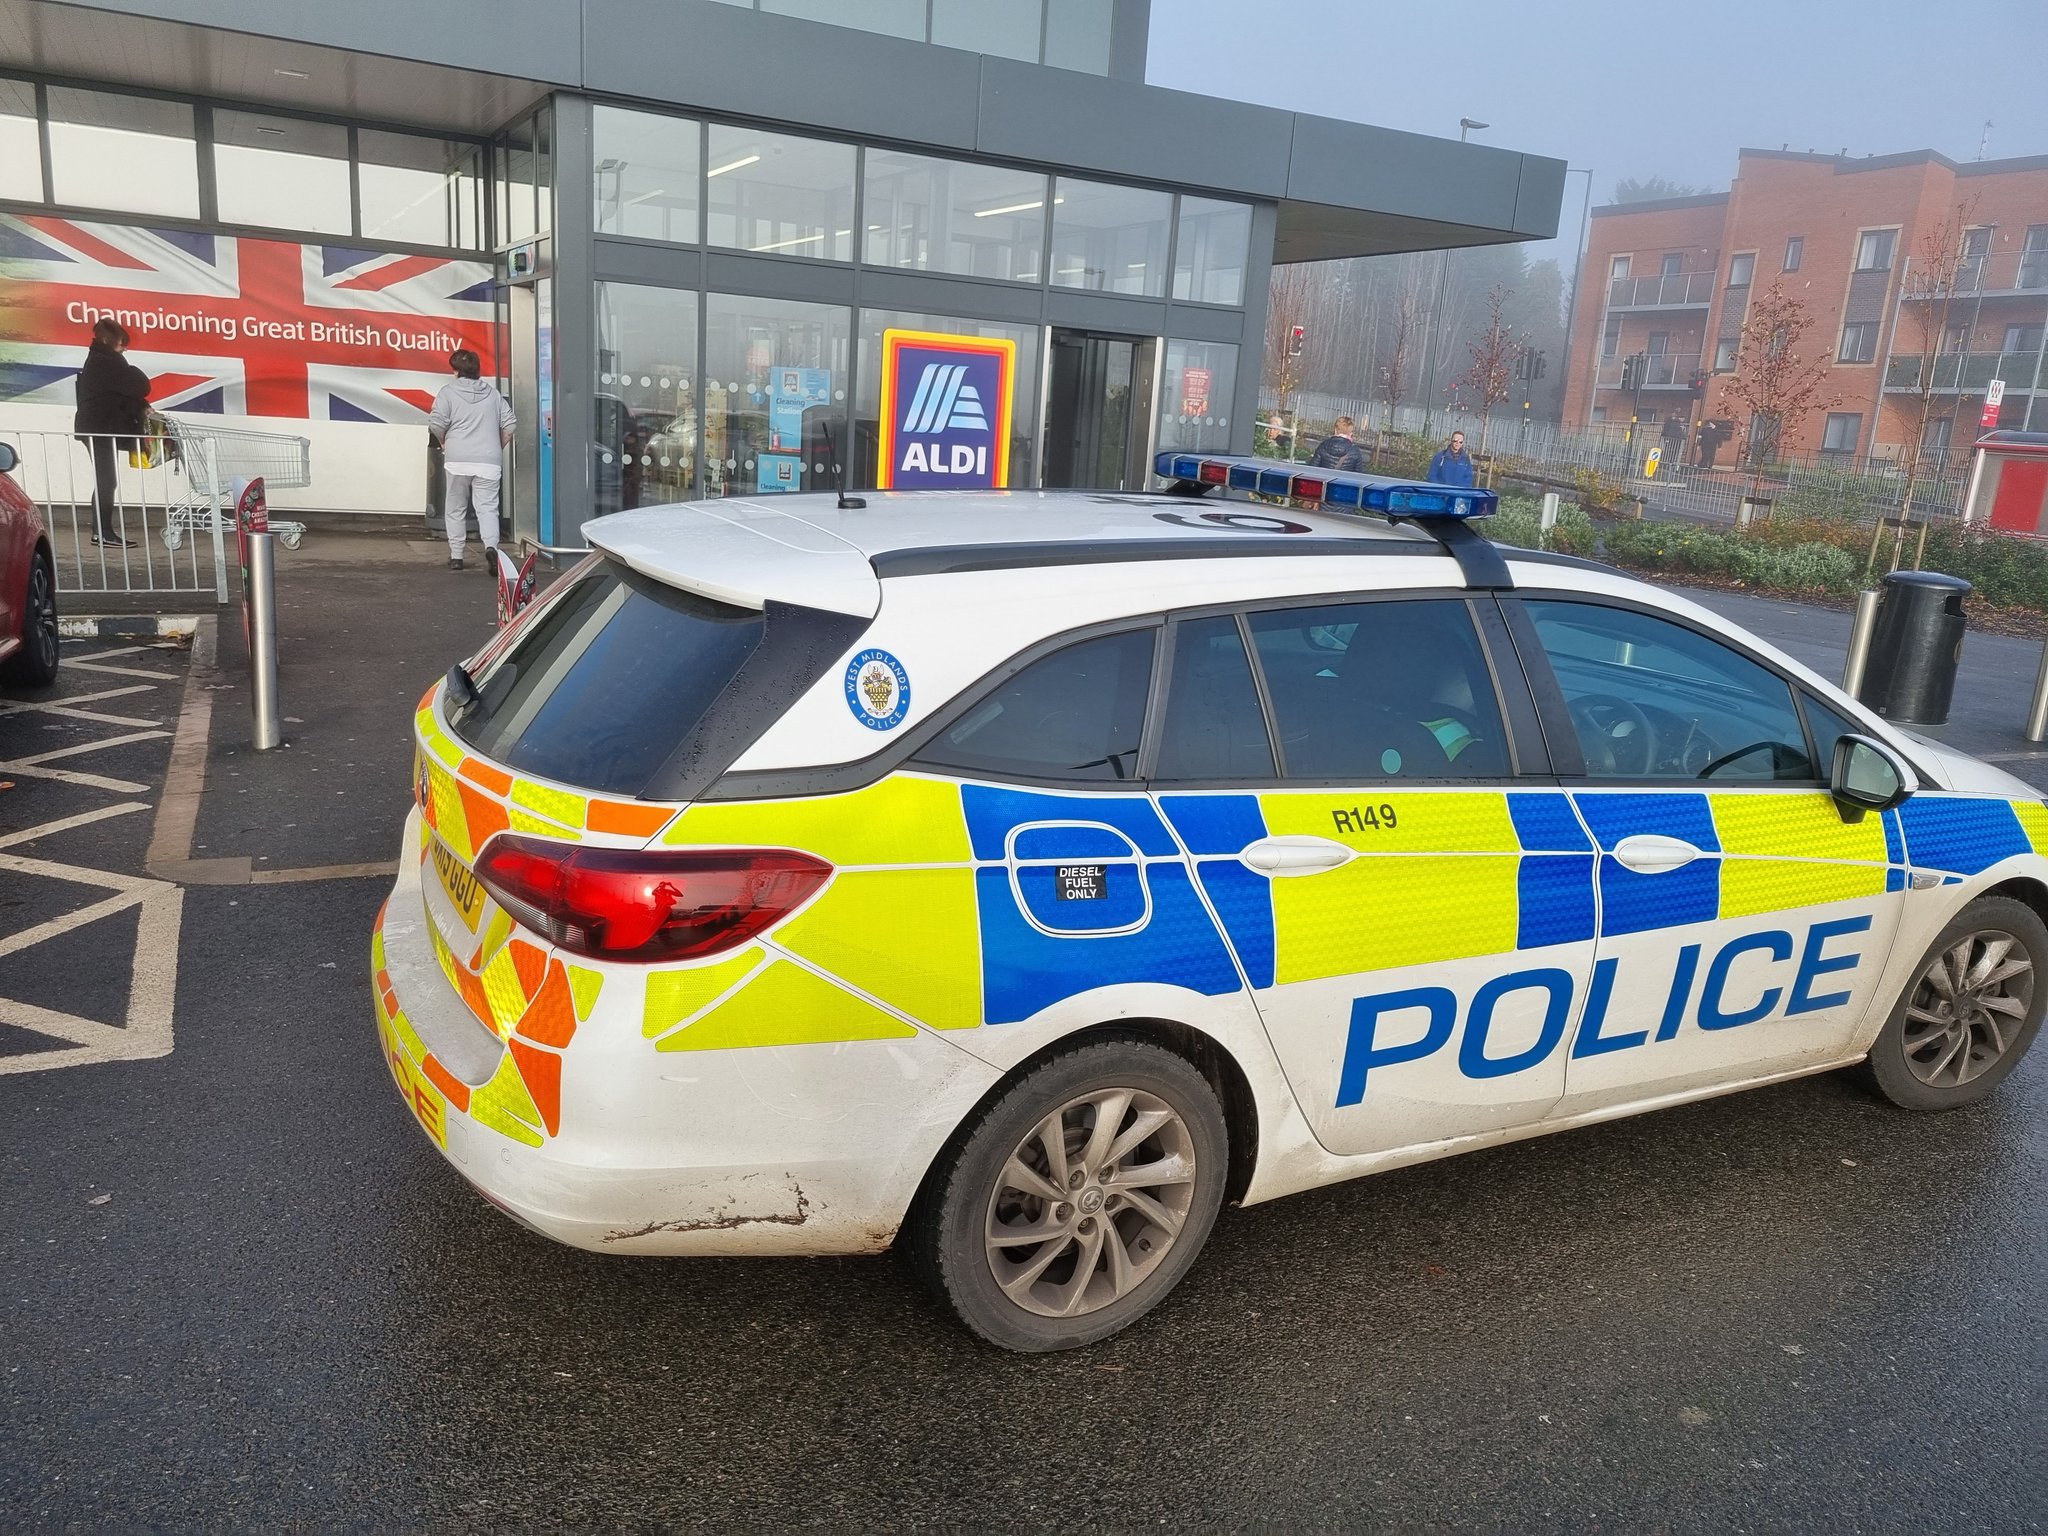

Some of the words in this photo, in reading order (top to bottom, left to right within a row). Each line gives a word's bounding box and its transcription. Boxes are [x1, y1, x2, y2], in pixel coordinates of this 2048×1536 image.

[242, 316, 305, 341] Great
[310, 321, 381, 347] British
[776, 398, 806, 407] Cleaning
[777, 406, 803, 415] Station
[901, 442, 987, 475] ALDI
[760, 482, 786, 491] Cleaning
[848, 661, 860, 692] WEST
[861, 652, 908, 691] MIDLANDS
[859, 711, 902, 729] POLICE
[1331, 803, 1398, 834] R149
[1060, 867, 1101, 878] DIESEL
[1065, 877, 1096, 888] FUEL
[1066, 888, 1097, 900] ONLY
[1335, 915, 1873, 1108] POLICE
